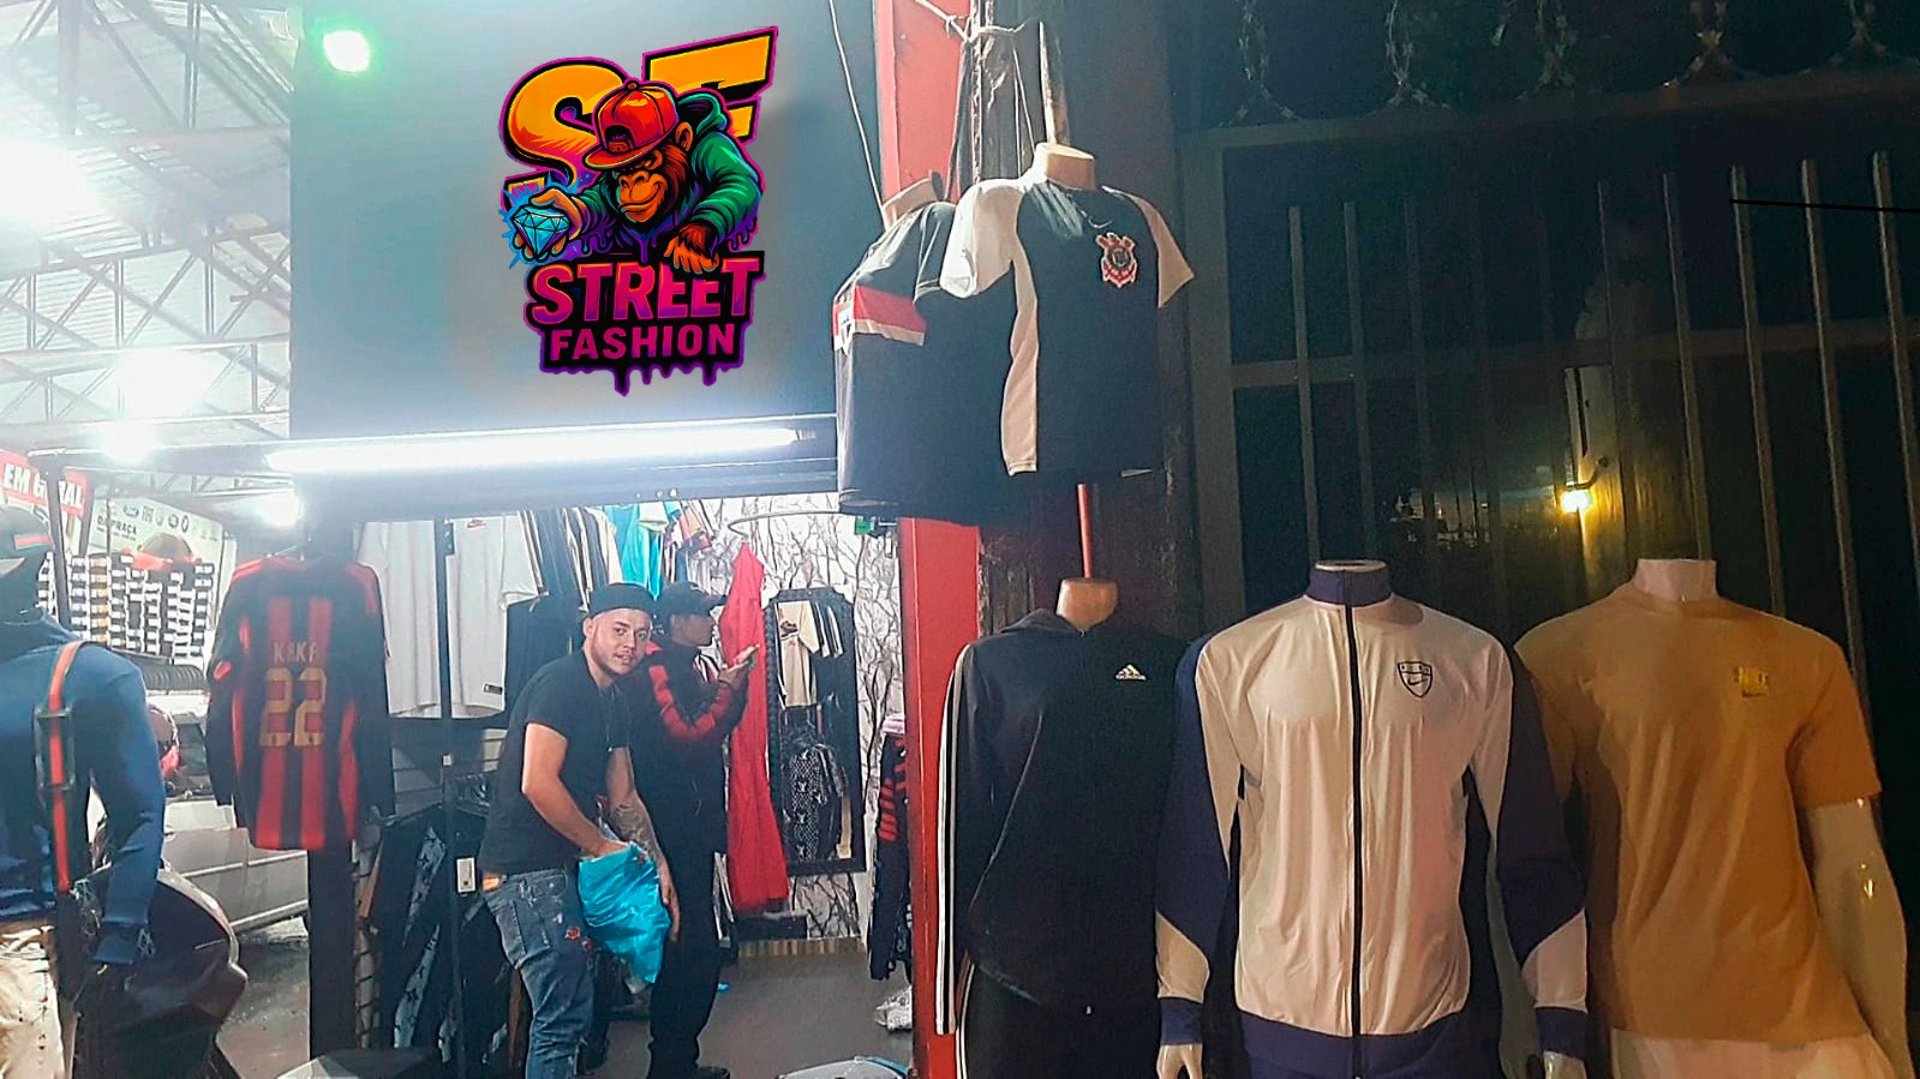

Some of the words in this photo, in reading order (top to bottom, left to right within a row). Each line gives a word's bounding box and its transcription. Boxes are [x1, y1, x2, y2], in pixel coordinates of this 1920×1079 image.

[531, 256, 760, 325] STREET
[549, 323, 735, 361] FASHION
[3, 461, 31, 494] EM
[33, 472, 85, 509] GRAL
[260, 667, 327, 746] 22
